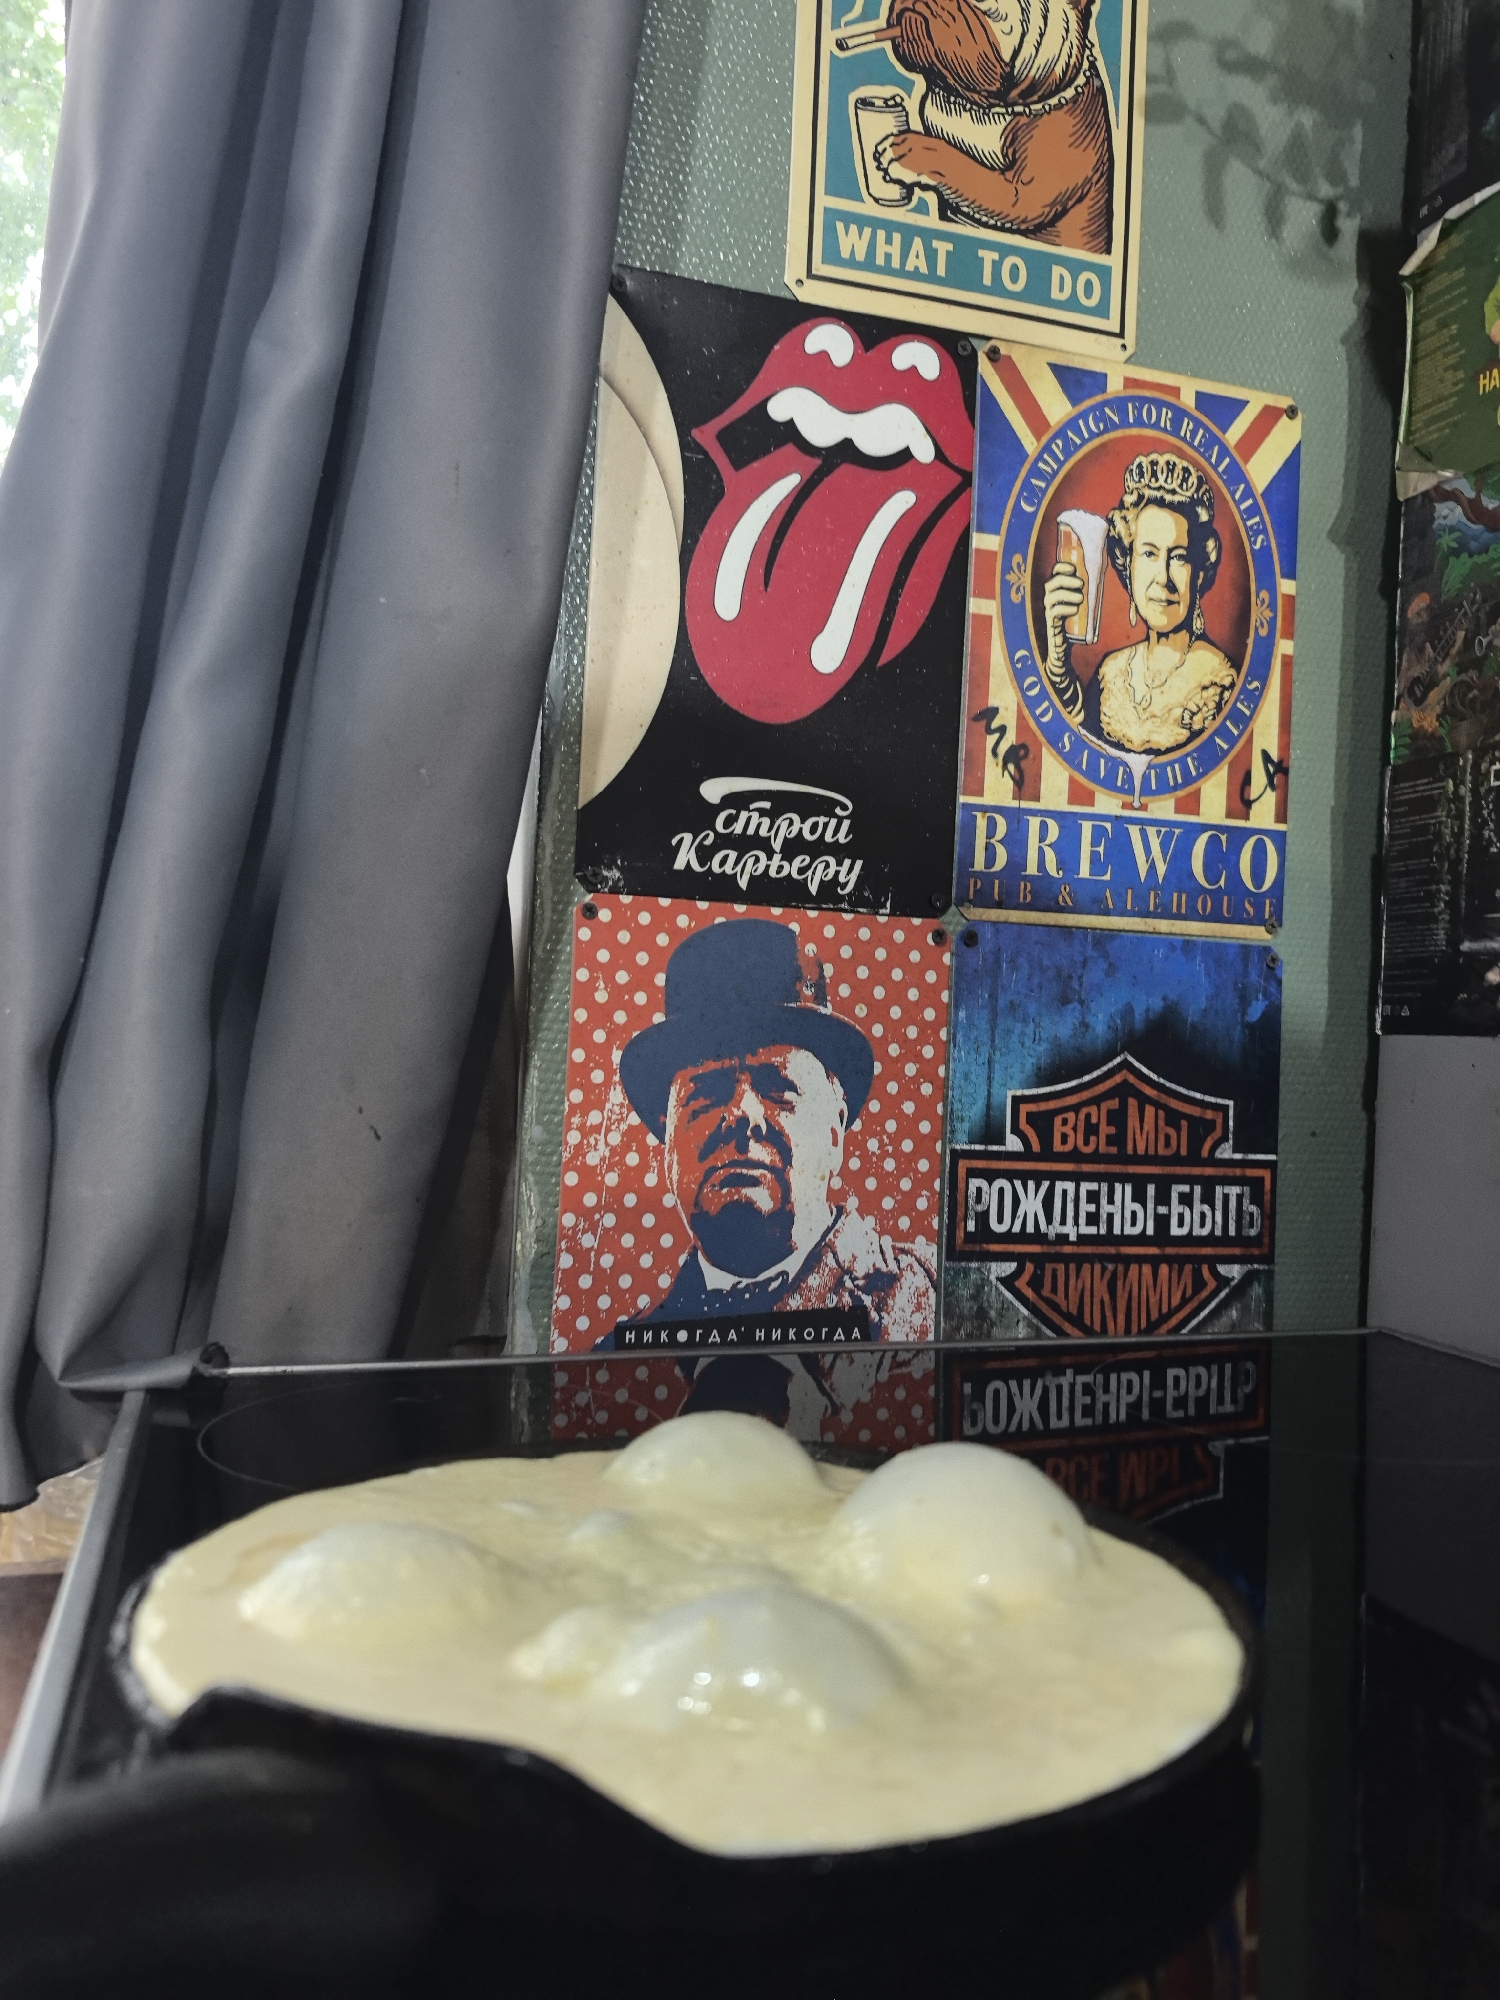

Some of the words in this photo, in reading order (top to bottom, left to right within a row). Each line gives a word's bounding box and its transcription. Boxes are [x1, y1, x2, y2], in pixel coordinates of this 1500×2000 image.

[835, 220, 954, 278] WHAT
[978, 249, 1028, 293] TO
[1050, 264, 1101, 308] DO
[1020, 404, 1121, 513] CAMPAIGN
[1126, 401, 1173, 433] FOR
[1180, 418, 1228, 480] REAL
[1229, 483, 1269, 551] ALES
[1014, 649, 1056, 723] GOD
[1058, 731, 1131, 790] SAVE
[1145, 753, 1204, 791] THE
[1213, 676, 1262, 757] ALES
[700, 776, 854, 853] строй
[968, 810, 1280, 894] BREWCO
[671, 830, 864, 897] Карьеру
[968, 877, 1033, 904] PUB
[1057, 883, 1076, 907] &
[1101, 883, 1277, 920] ALEHOUSE
[1053, 1097, 1121, 1155] ВСЕ
[966, 1177, 1262, 1242] РОЖДЕНЫ-БЫТЬ
[755, 1326, 862, 1342] НИКОГДА
[1041, 1262, 1195, 1337] ДИКИМИ
